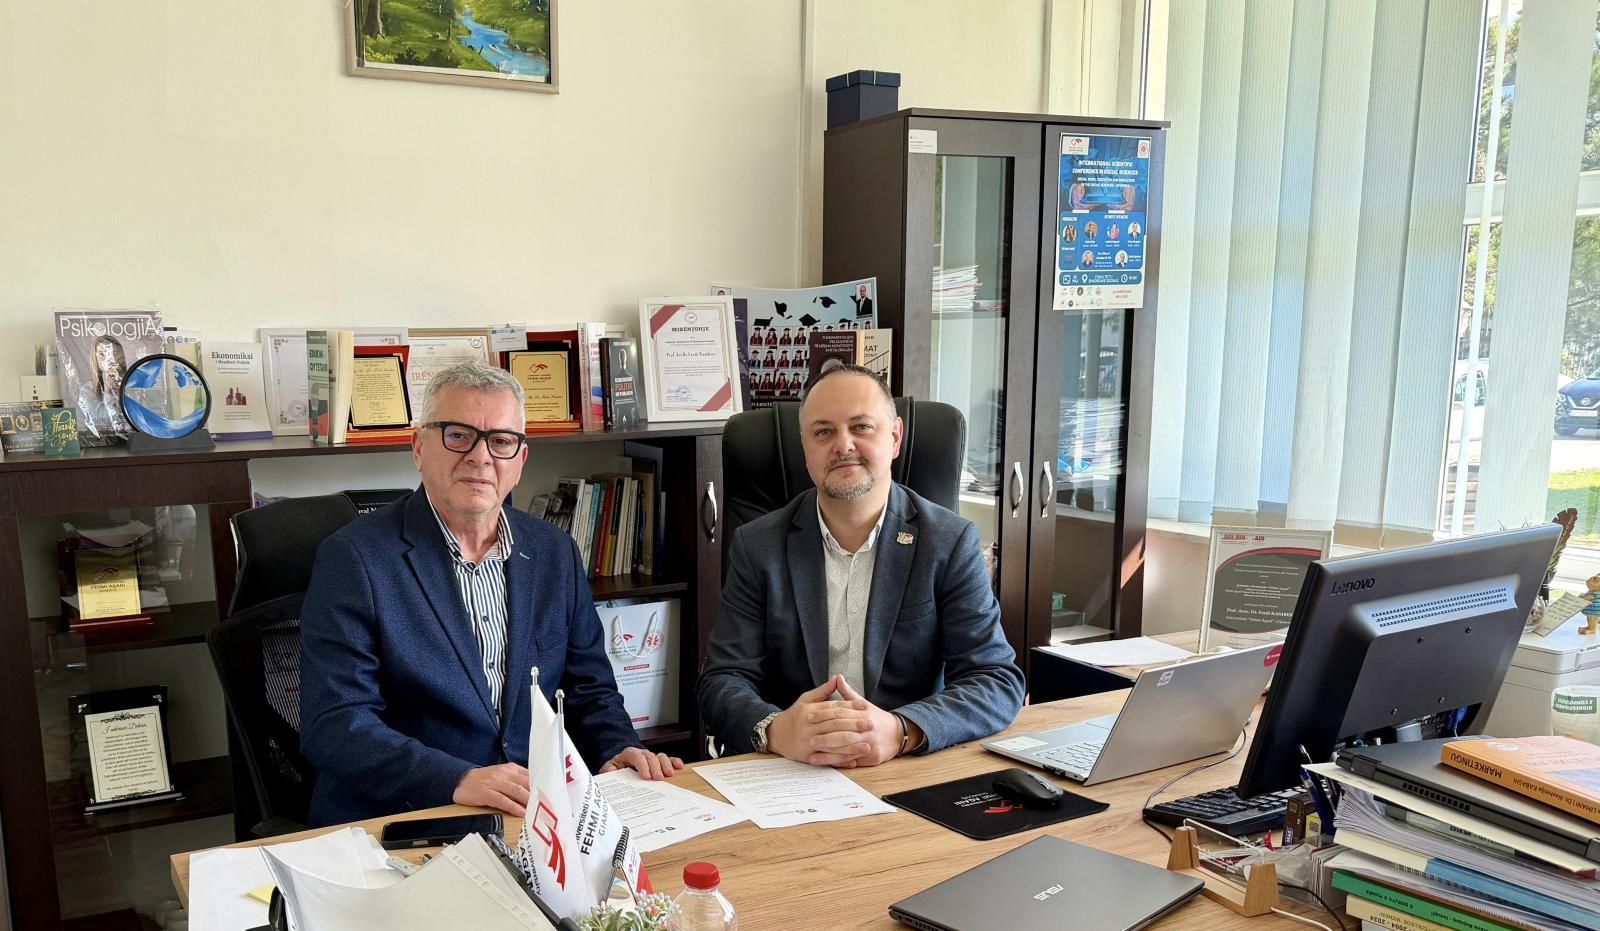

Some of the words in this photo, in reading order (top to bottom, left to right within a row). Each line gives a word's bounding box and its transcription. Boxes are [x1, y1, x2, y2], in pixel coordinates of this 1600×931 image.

[211, 351, 253, 360] Ekonomiksi
[1331, 577, 1375, 594] Lenovo
[1450, 752, 1502, 779] MARKETINGU
[581, 810, 598, 855] FEHMI
[1033, 884, 1065, 901] ASUS
[1369, 916, 1386, 926] 2024
